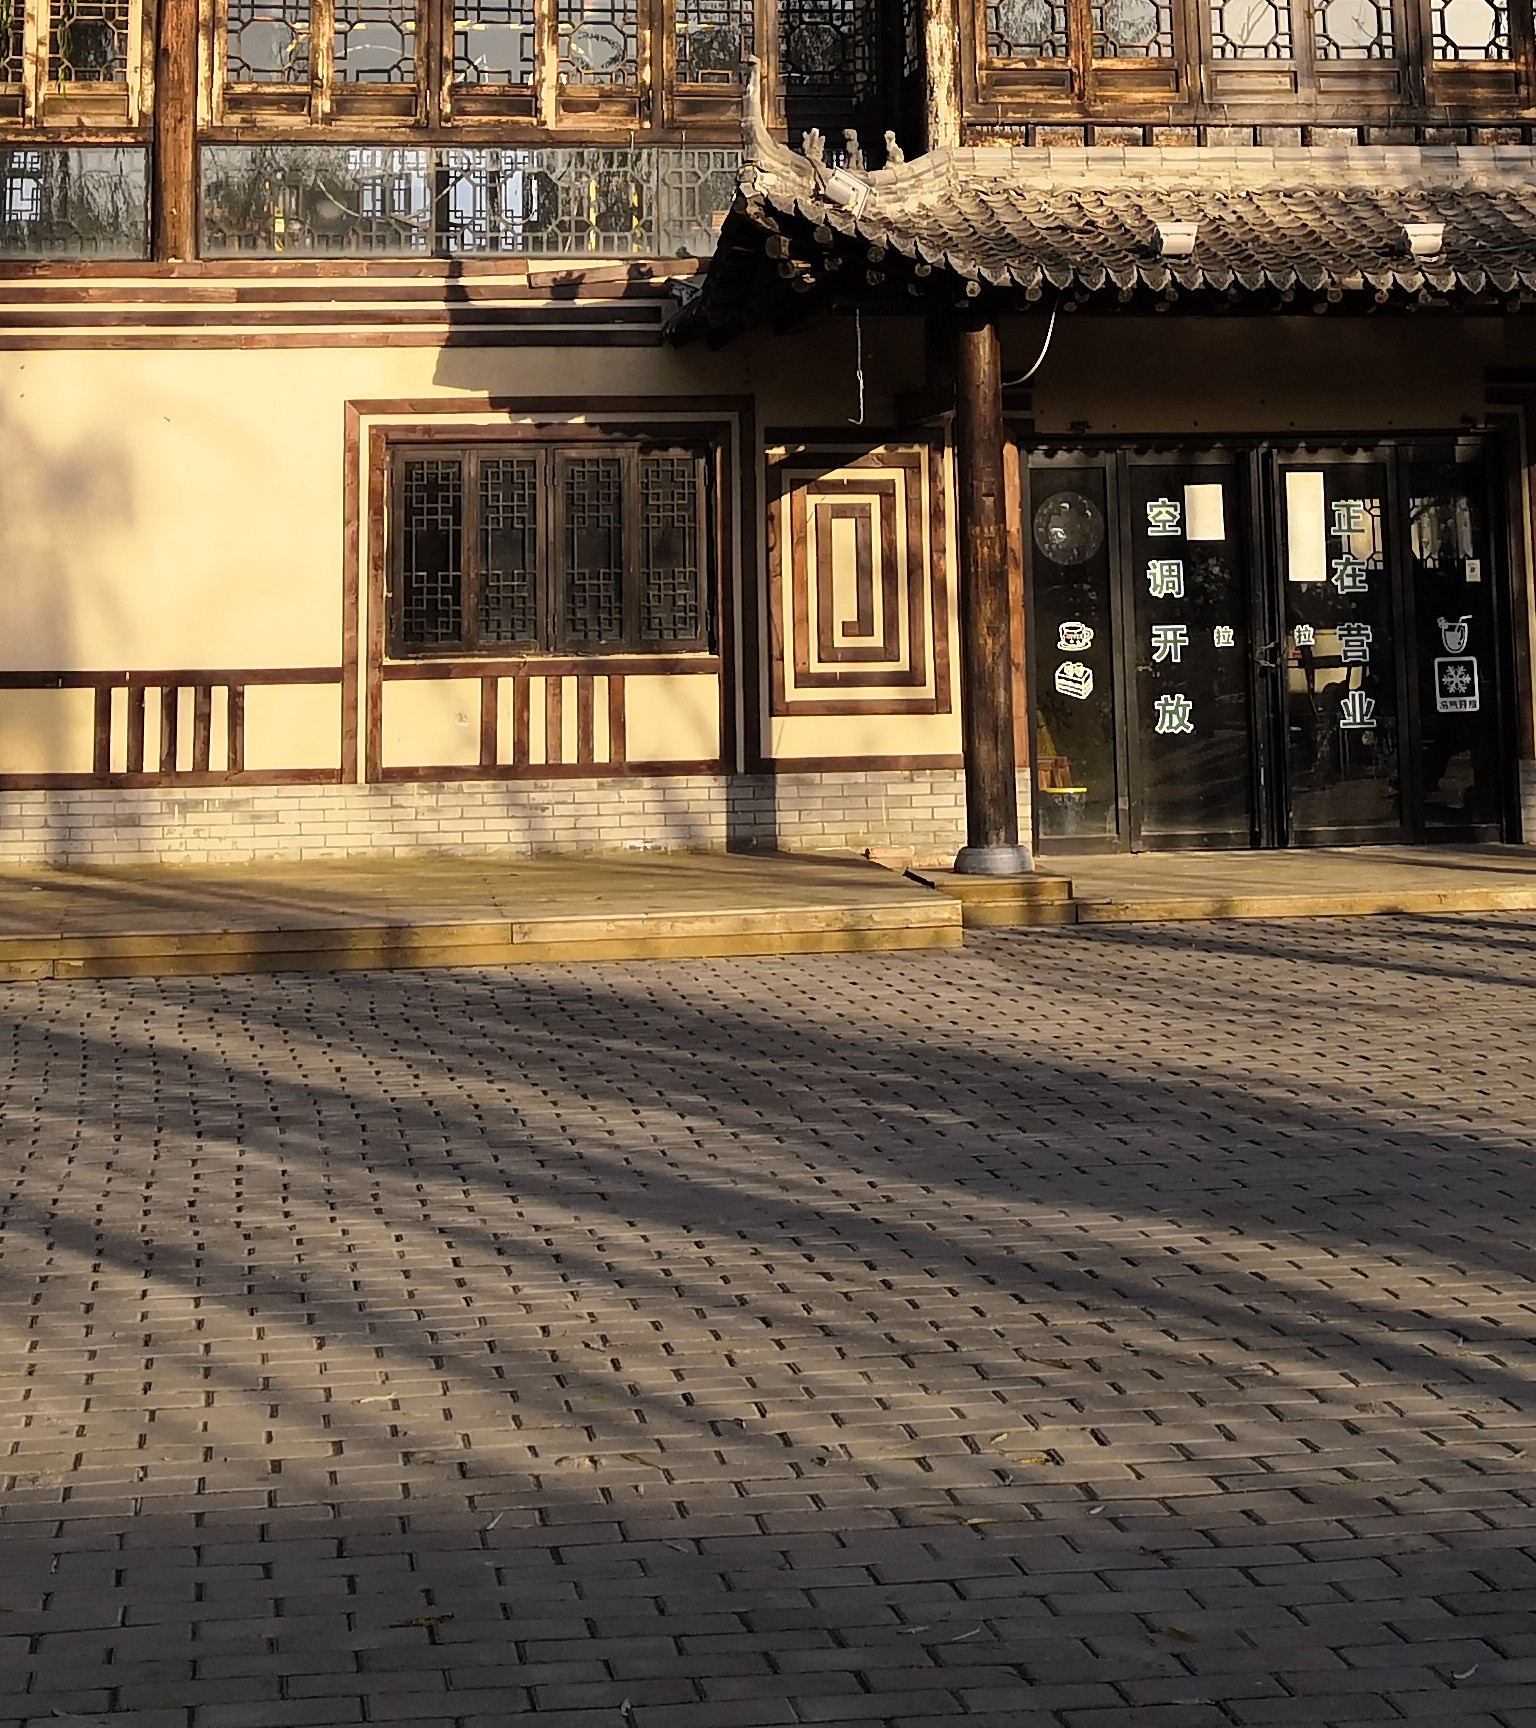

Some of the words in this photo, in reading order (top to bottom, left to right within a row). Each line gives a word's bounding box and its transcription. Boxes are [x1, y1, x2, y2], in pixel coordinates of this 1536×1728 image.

[1147, 498, 1194, 734] 空调开放
[1214, 626, 1234, 647] 拉
[1294, 624, 1315, 646] 拉
[1331, 499, 1376, 729] 正在营业
